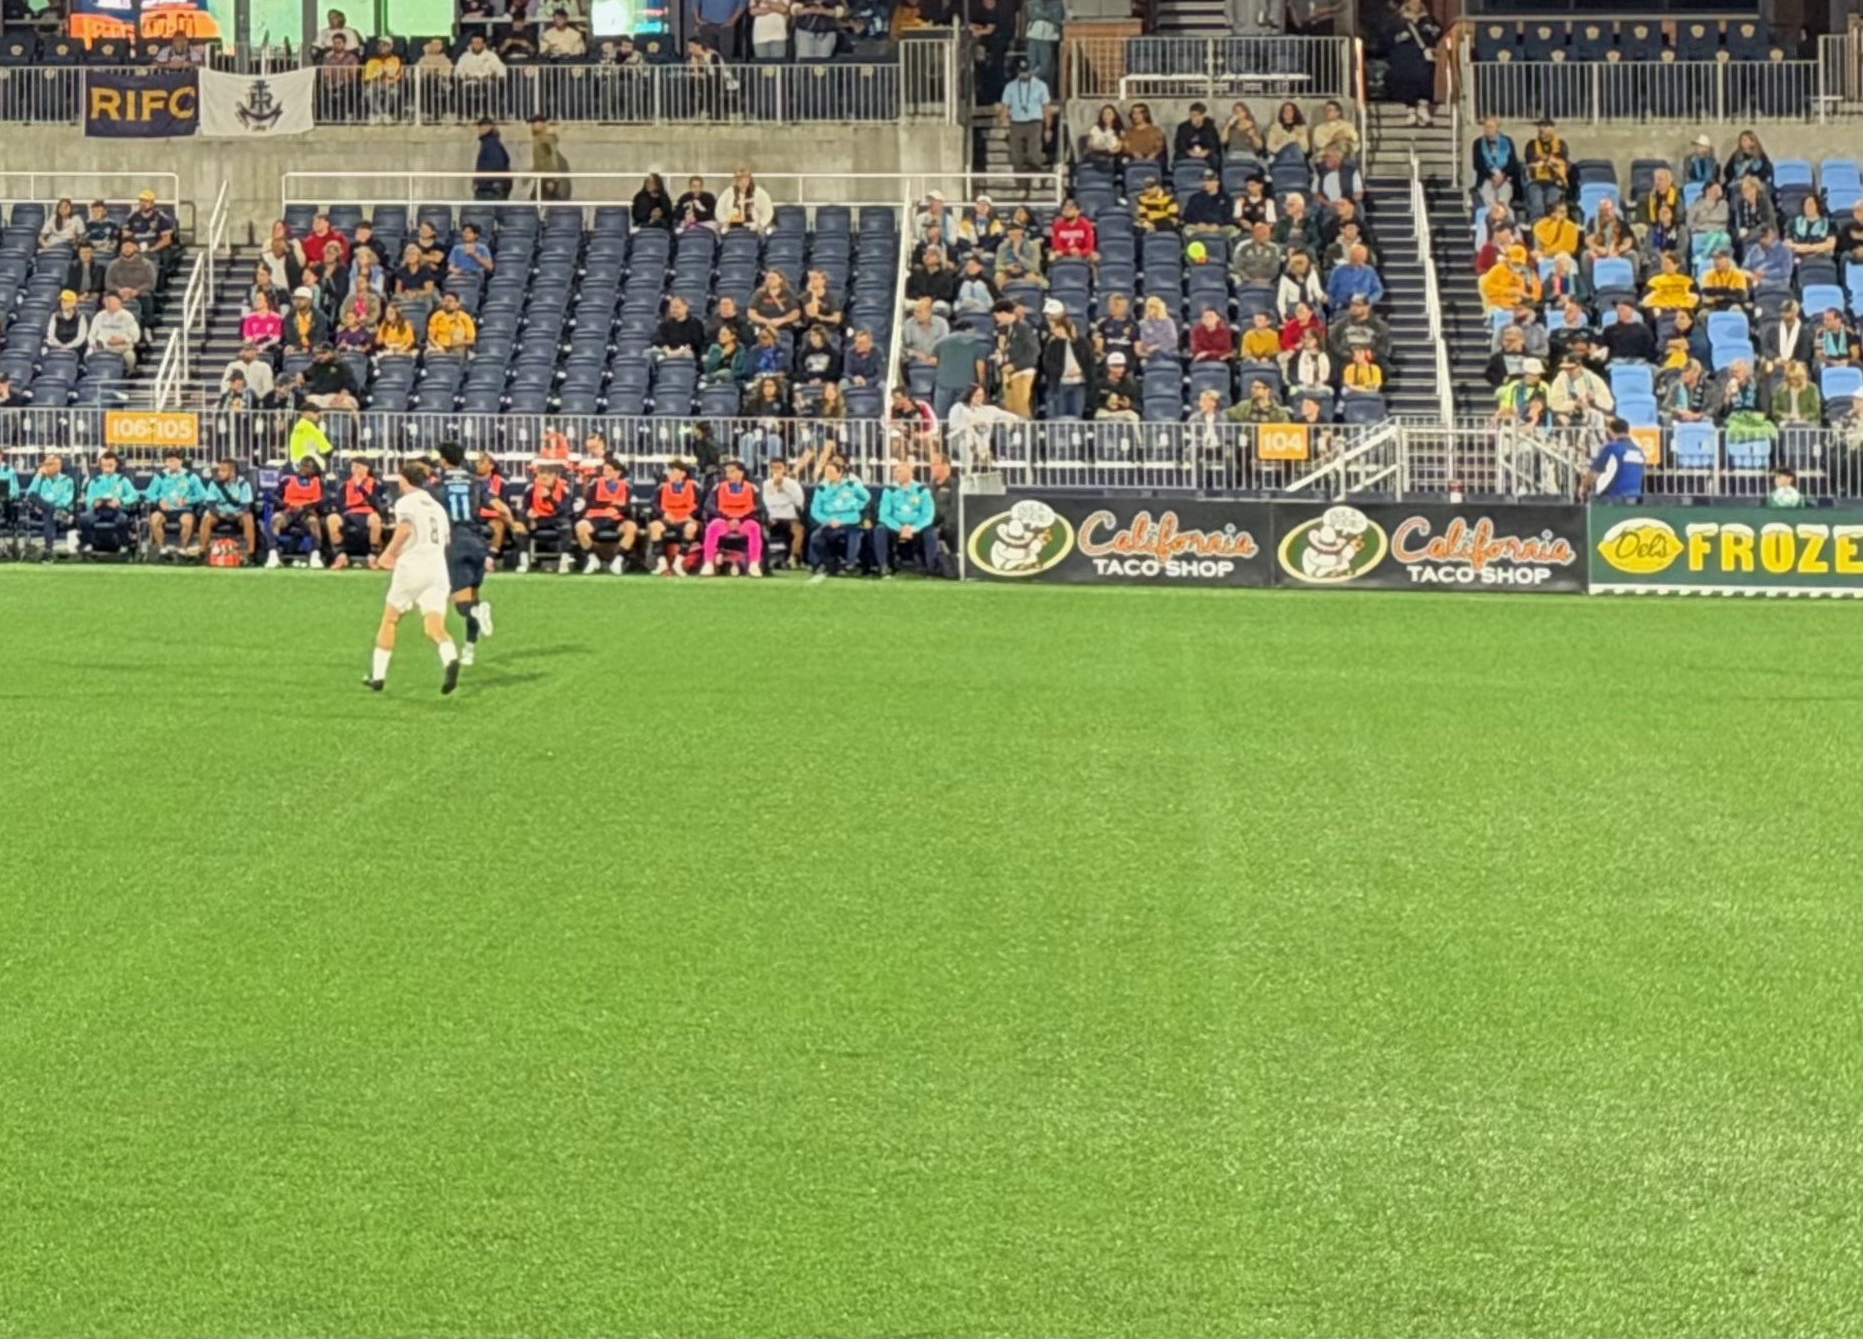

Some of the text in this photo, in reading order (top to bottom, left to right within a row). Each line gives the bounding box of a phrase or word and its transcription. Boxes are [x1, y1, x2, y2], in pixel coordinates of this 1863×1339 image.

[90, 86, 196, 122] RIFC
[1264, 431, 1303, 452] 104
[449, 494, 471, 522] 11
[1077, 509, 1259, 563] California
[1391, 516, 1576, 570] California
[1686, 522, 1863, 574] FROZE
[1093, 559, 1234, 578] TACO SHOP
[1407, 565, 1551, 584] TACO SHOP
